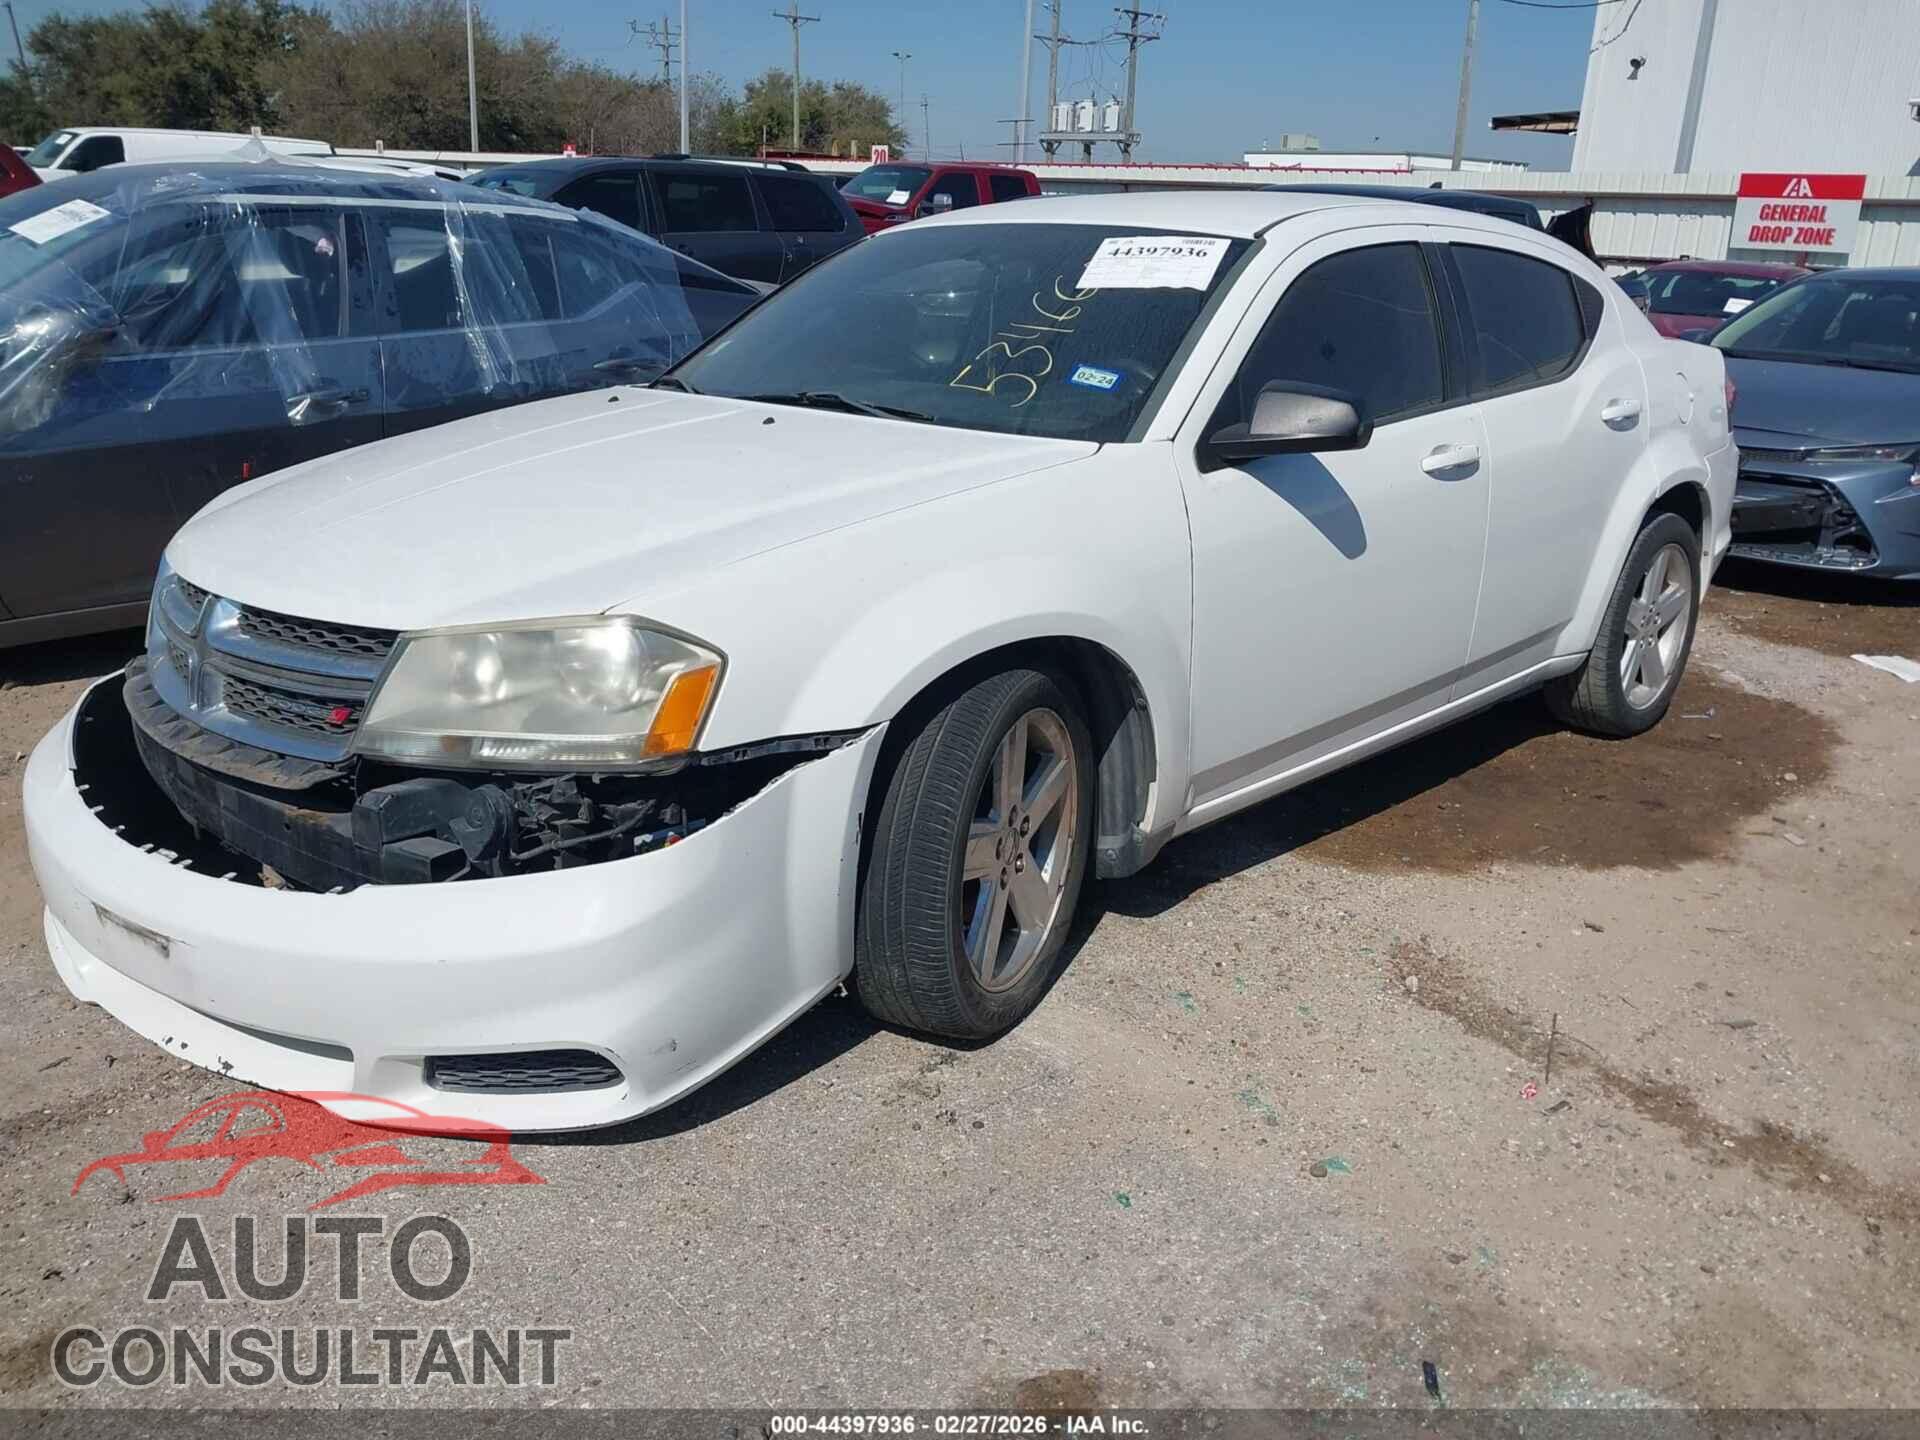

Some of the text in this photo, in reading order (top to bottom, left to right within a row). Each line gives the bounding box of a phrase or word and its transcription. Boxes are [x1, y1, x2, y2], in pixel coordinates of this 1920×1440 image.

[873, 149, 887, 165] 20
[1759, 204, 1828, 223] GENERAL
[1749, 225, 1836, 245] DROP ZONE
[1108, 246, 1208, 258] 44397936
